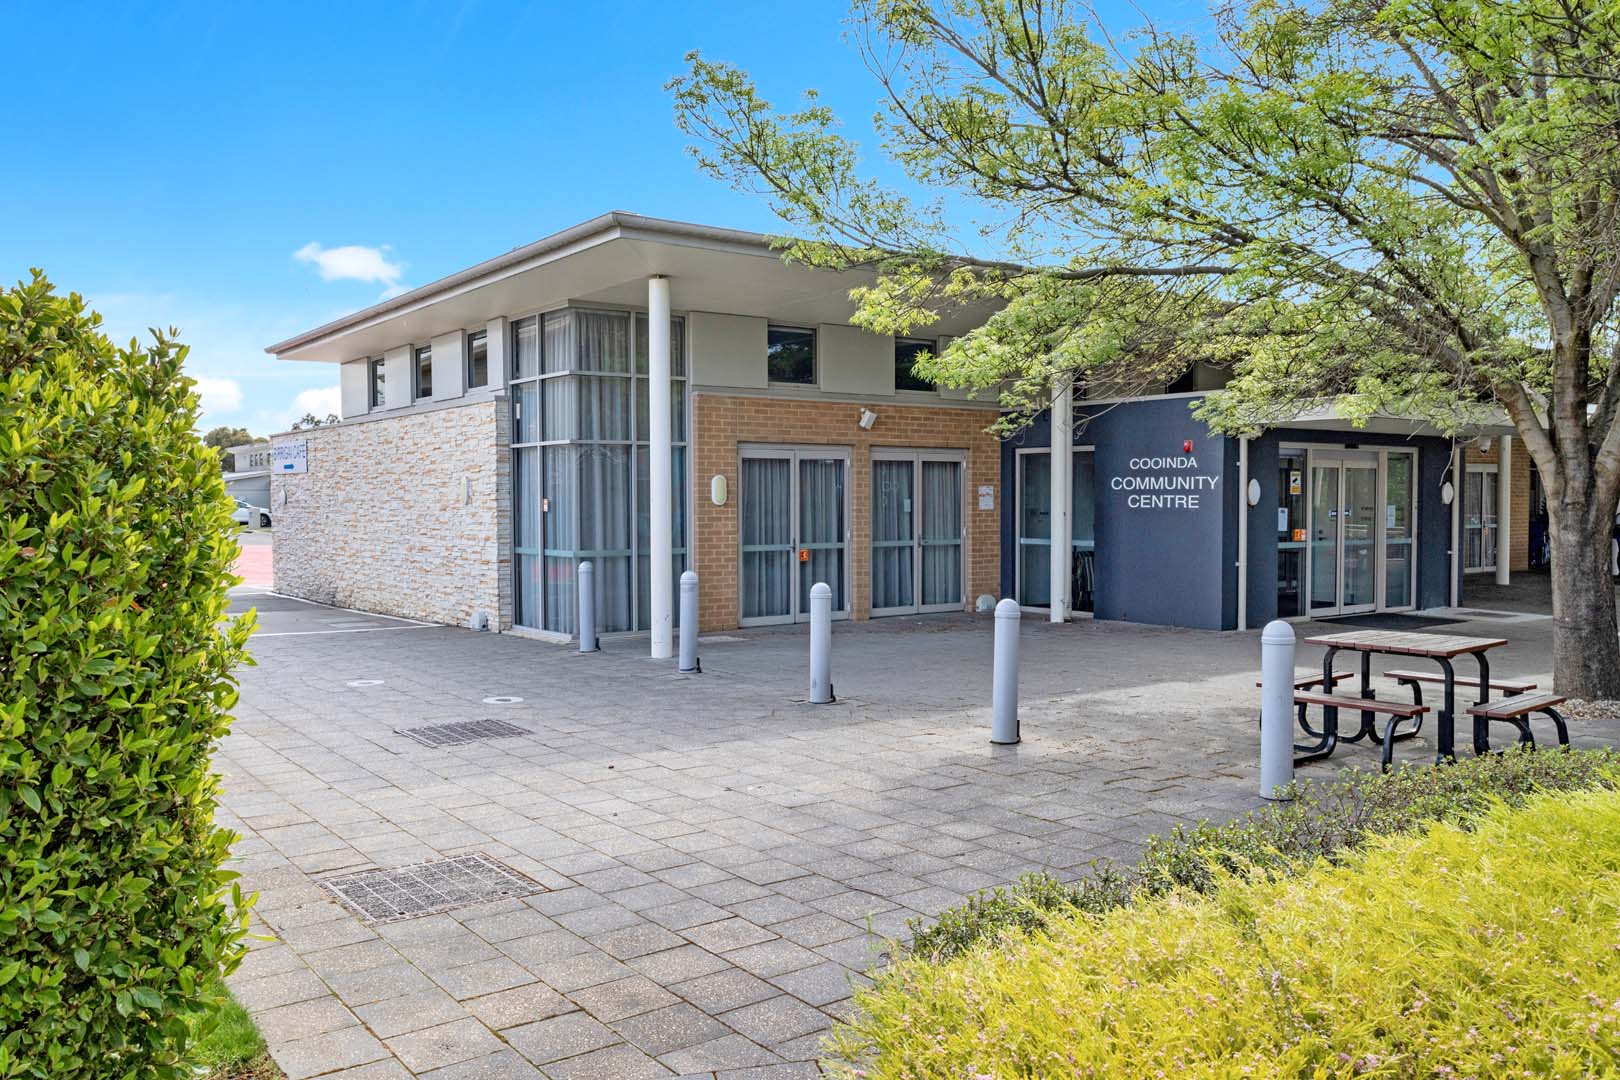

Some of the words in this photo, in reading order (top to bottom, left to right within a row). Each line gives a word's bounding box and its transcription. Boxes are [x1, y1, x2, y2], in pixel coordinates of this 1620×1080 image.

[1129, 457, 1198, 469] COOINDA
[1111, 476, 1219, 490] COMMUNITY
[1128, 495, 1199, 508] CENTRE
